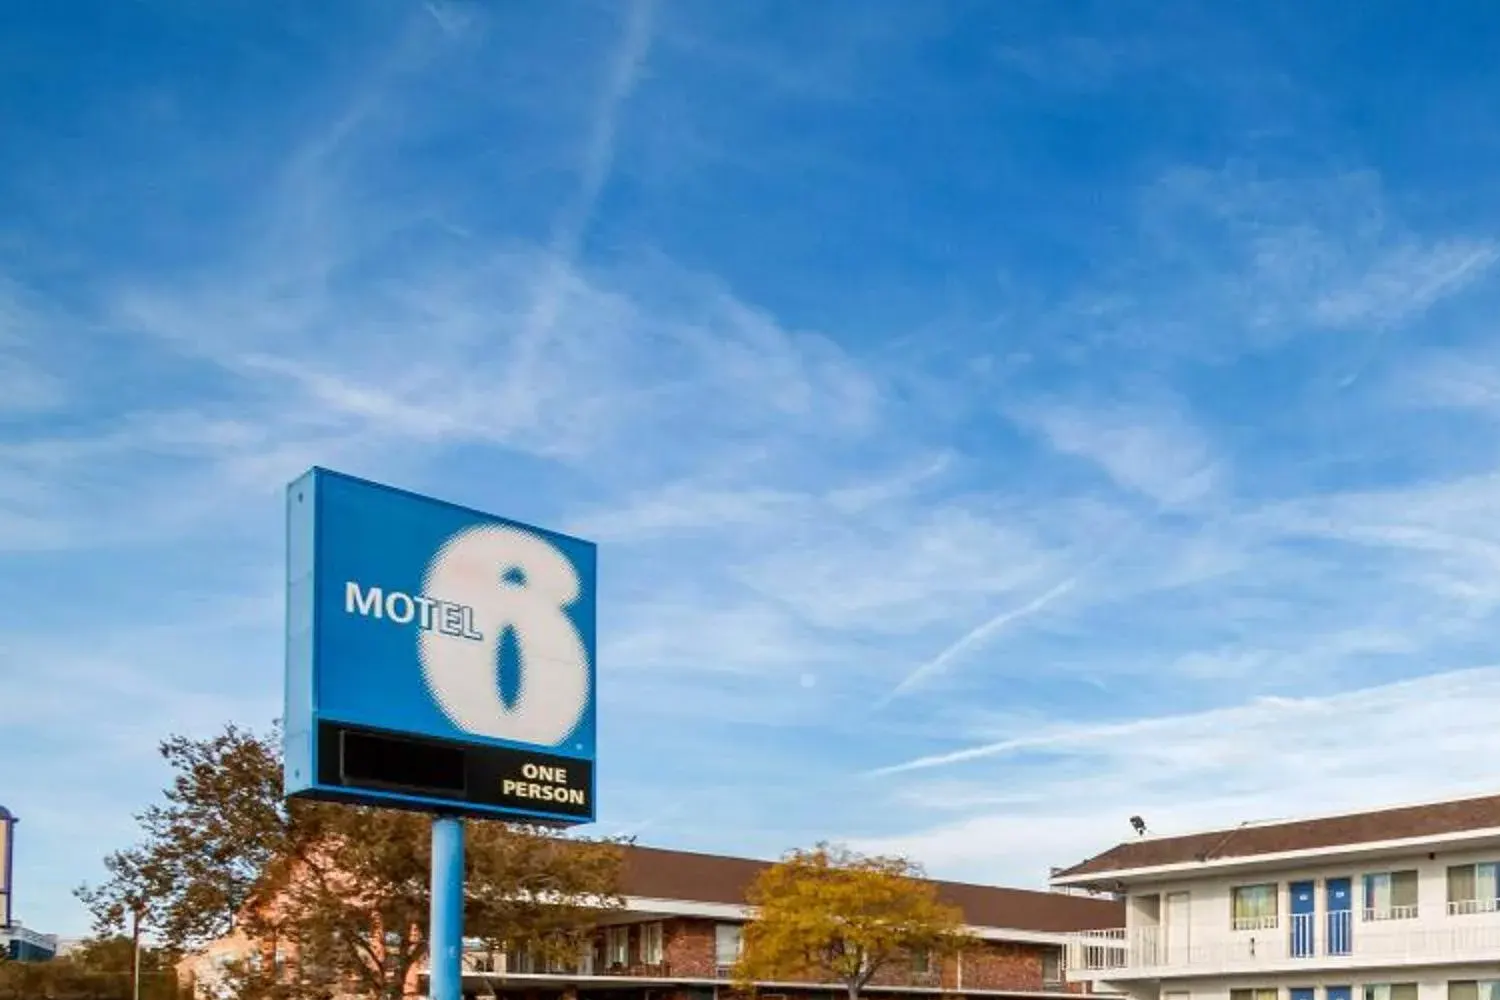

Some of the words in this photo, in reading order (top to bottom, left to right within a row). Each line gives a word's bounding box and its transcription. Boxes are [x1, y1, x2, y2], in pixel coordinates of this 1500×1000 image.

[345, 581, 484, 641] MOTEL
[418, 523, 591, 747] 6
[521, 763, 567, 784] ONE
[502, 779, 585, 805] PERSON
